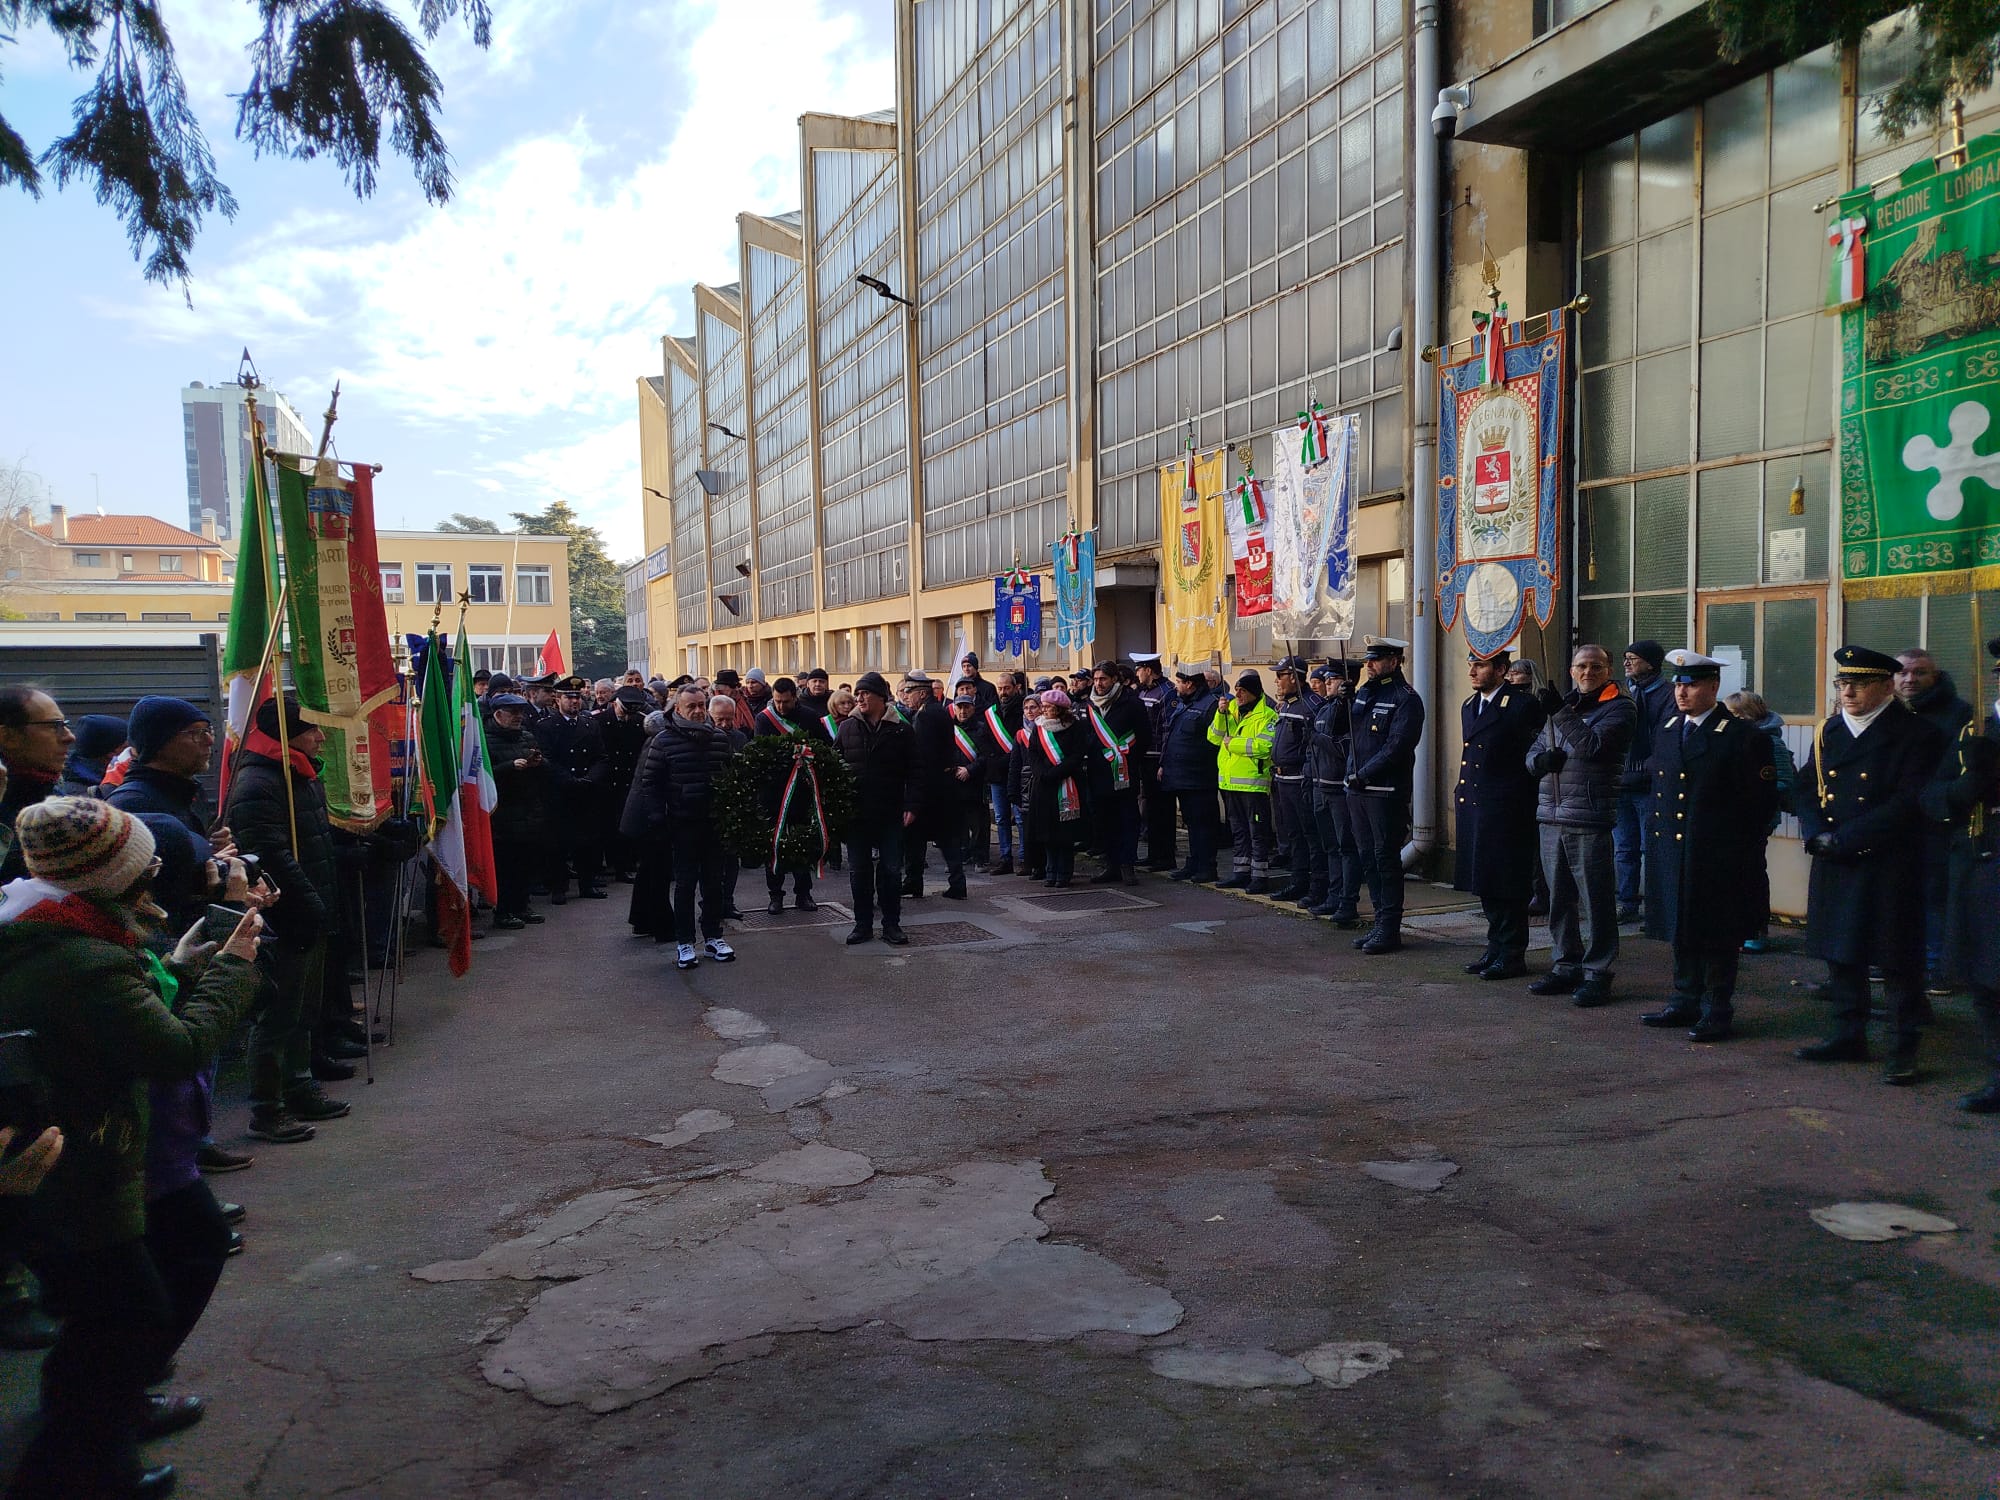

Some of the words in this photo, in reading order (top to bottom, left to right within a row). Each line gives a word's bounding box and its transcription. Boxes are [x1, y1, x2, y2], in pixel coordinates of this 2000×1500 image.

[1877, 187, 1932, 230] REGIONE
[1945, 158, 2000, 203] LOMBA
[1471, 408, 1521, 430] LEGNANO
[1250, 546, 1264, 564] B
